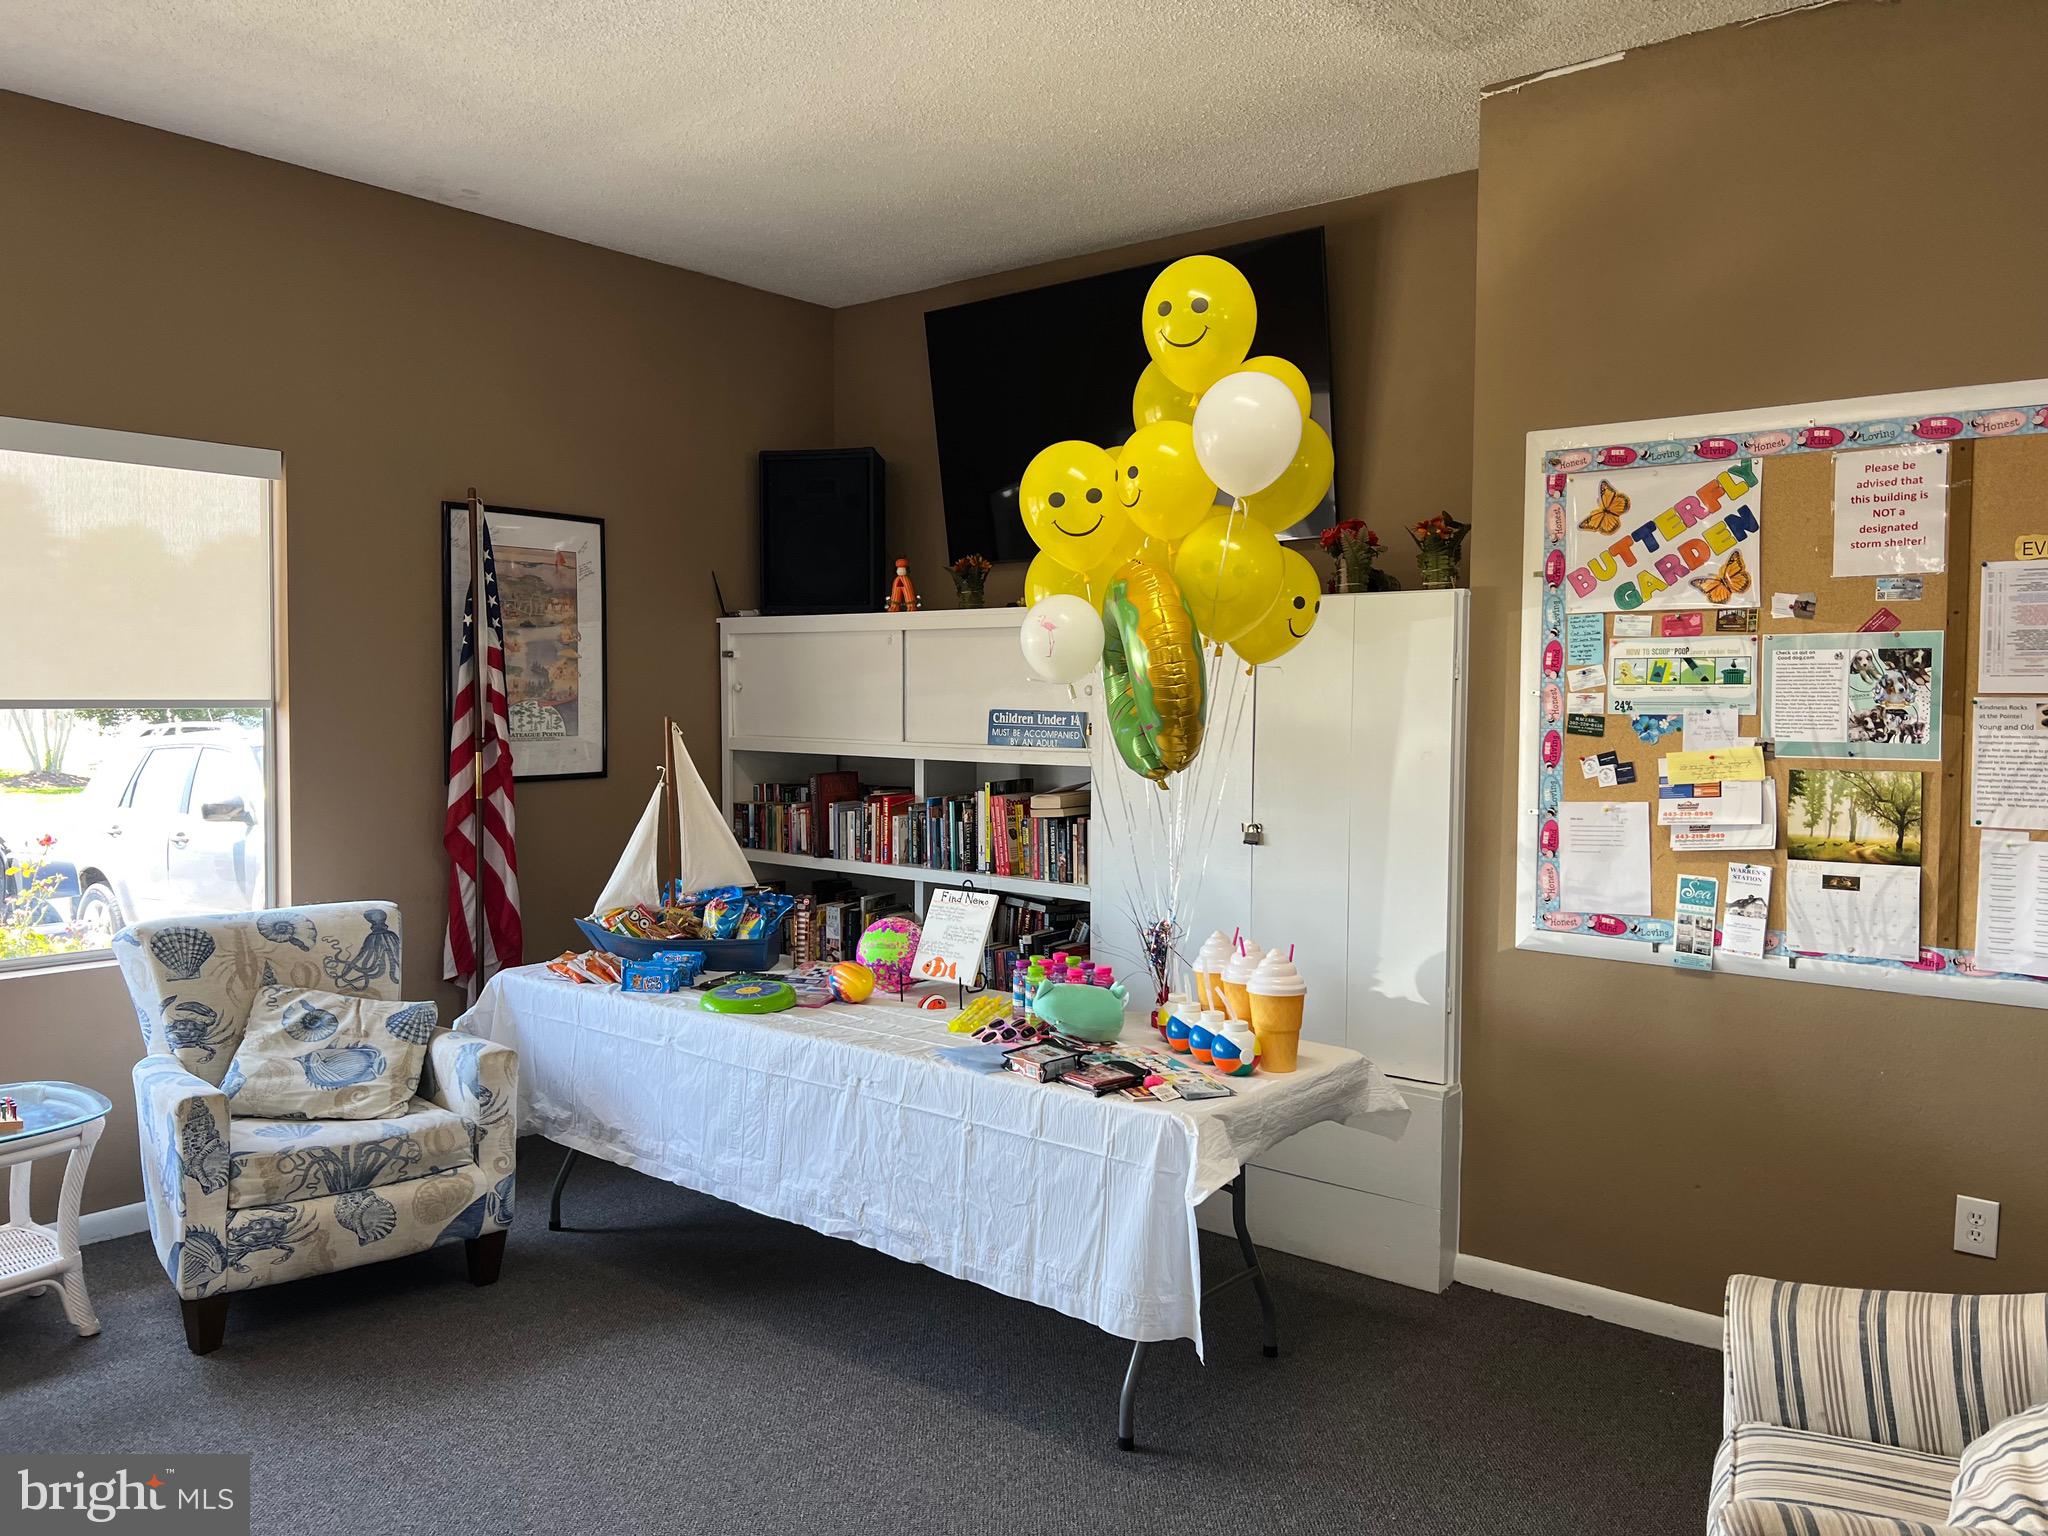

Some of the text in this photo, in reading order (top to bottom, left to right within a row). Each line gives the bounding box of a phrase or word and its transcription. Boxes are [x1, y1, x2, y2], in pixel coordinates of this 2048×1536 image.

[1930, 419, 1947, 427] BEE
[1982, 418, 2020, 433] Honest
[1813, 429, 1830, 437] BEE
[1861, 428, 1896, 442] Loving
[1921, 425, 1956, 436] Giving
[1753, 438, 1786, 452] Honest
[1810, 436, 1834, 446] Kind
[1651, 450, 1680, 462] Loving
[1701, 446, 1732, 458] Giving
[1560, 458, 1587, 468] Honest
[1606, 455, 1628, 464] Kind
[1864, 461, 1916, 473] Please be
[1856, 476, 1924, 489] advised that
[1850, 490, 1928, 504] this building is
[1872, 508, 1896, 518] NOT
[1555, 506, 1564, 535] Honest
[1567, 460, 1758, 598] BUTTERFLY
[1859, 522, 1918, 534] designated
[1850, 536, 1926, 550] storm shelter!
[2023, 541, 2048, 556] EV
[1614, 504, 1760, 610] GARDEN
[1652, 648, 1670, 656] SCOOP
[1674, 647, 1690, 655] POOP
[1552, 688, 1560, 716] Honest
[1614, 700, 1633, 712] 24%
[992, 712, 1080, 726] Children Under 14
[992, 728, 1010, 736] MUST
[1024, 730, 1080, 740] ACCOMPANIED
[1550, 736, 1559, 761] Giving
[1730, 867, 1767, 876] WARREN'S
[1732, 874, 1763, 882] STATION
[1681, 880, 1712, 900] Sea
[941, 891, 989, 906] Find Nemo
[1600, 923, 1618, 933] Kind
[1640, 928, 1669, 937] Loving
